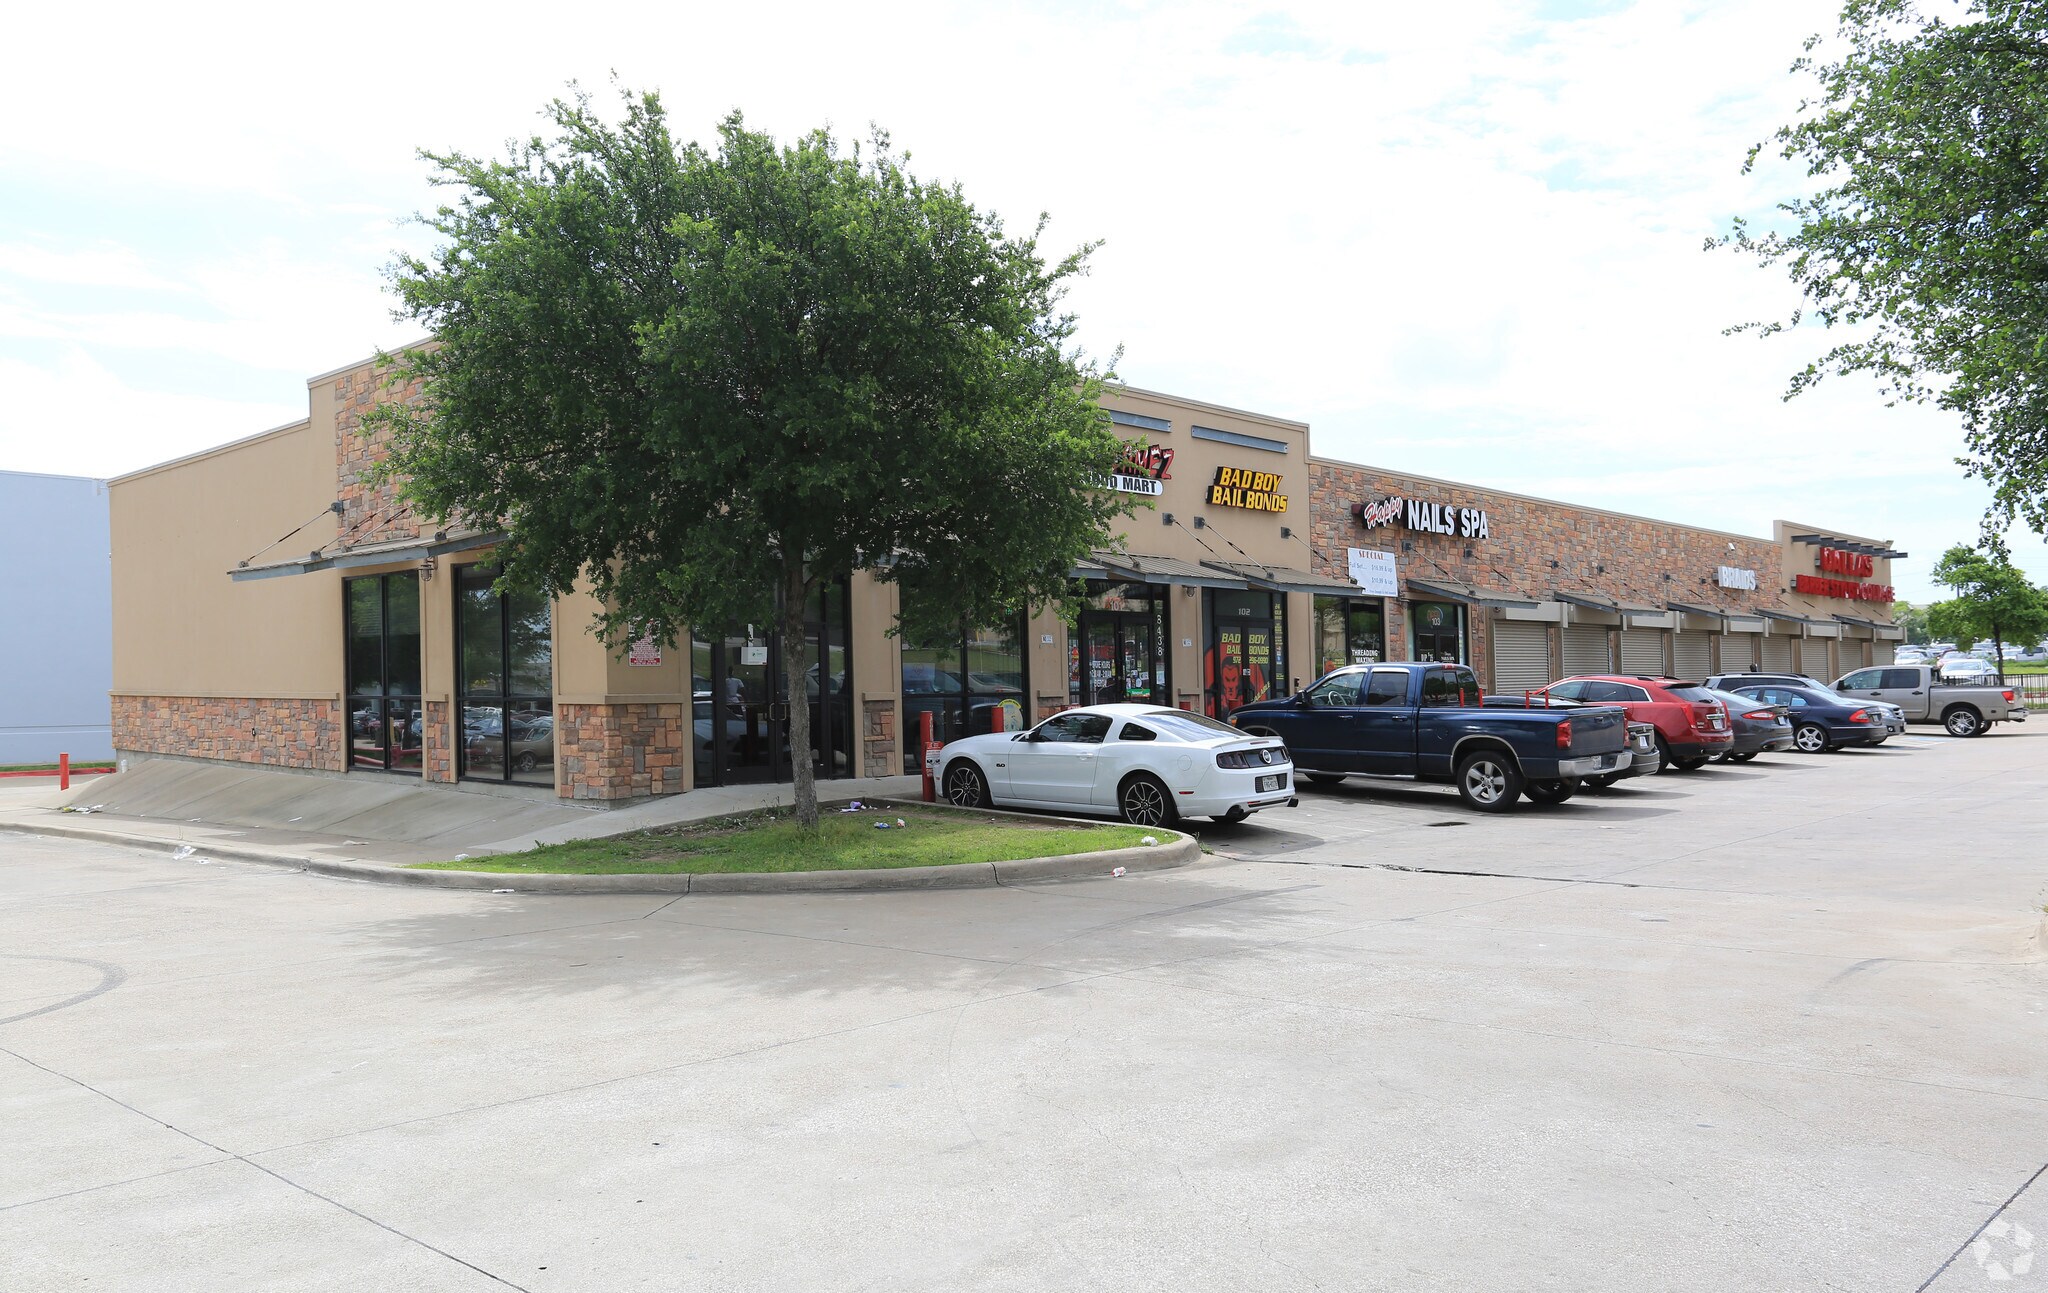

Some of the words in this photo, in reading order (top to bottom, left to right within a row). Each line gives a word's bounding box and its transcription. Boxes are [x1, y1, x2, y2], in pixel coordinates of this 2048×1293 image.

[1122, 477, 1157, 493] MART
[1219, 467, 1253, 489] BAD
[1252, 472, 1284, 493] BOY
[1211, 485, 1244, 508] BAIL
[1245, 490, 1288, 513] BONDS
[1364, 496, 1403, 530] Happy
[1407, 499, 1455, 536] NAILS
[1460, 507, 1489, 539] SPA
[1718, 566, 1757, 591] BRAIDS
[1238, 607, 1251, 616] 102
[1431, 617, 1441, 626] 103
[1156, 614, 1164, 656] 8438
[1221, 632, 1241, 643] BAD
[1248, 634, 1268, 644] BOY
[1226, 645, 1242, 655] BAIL
[1248, 645, 1269, 655] BONDS
[1351, 649, 1379, 657] THREADING
[1355, 656, 1375, 664] WAXING
